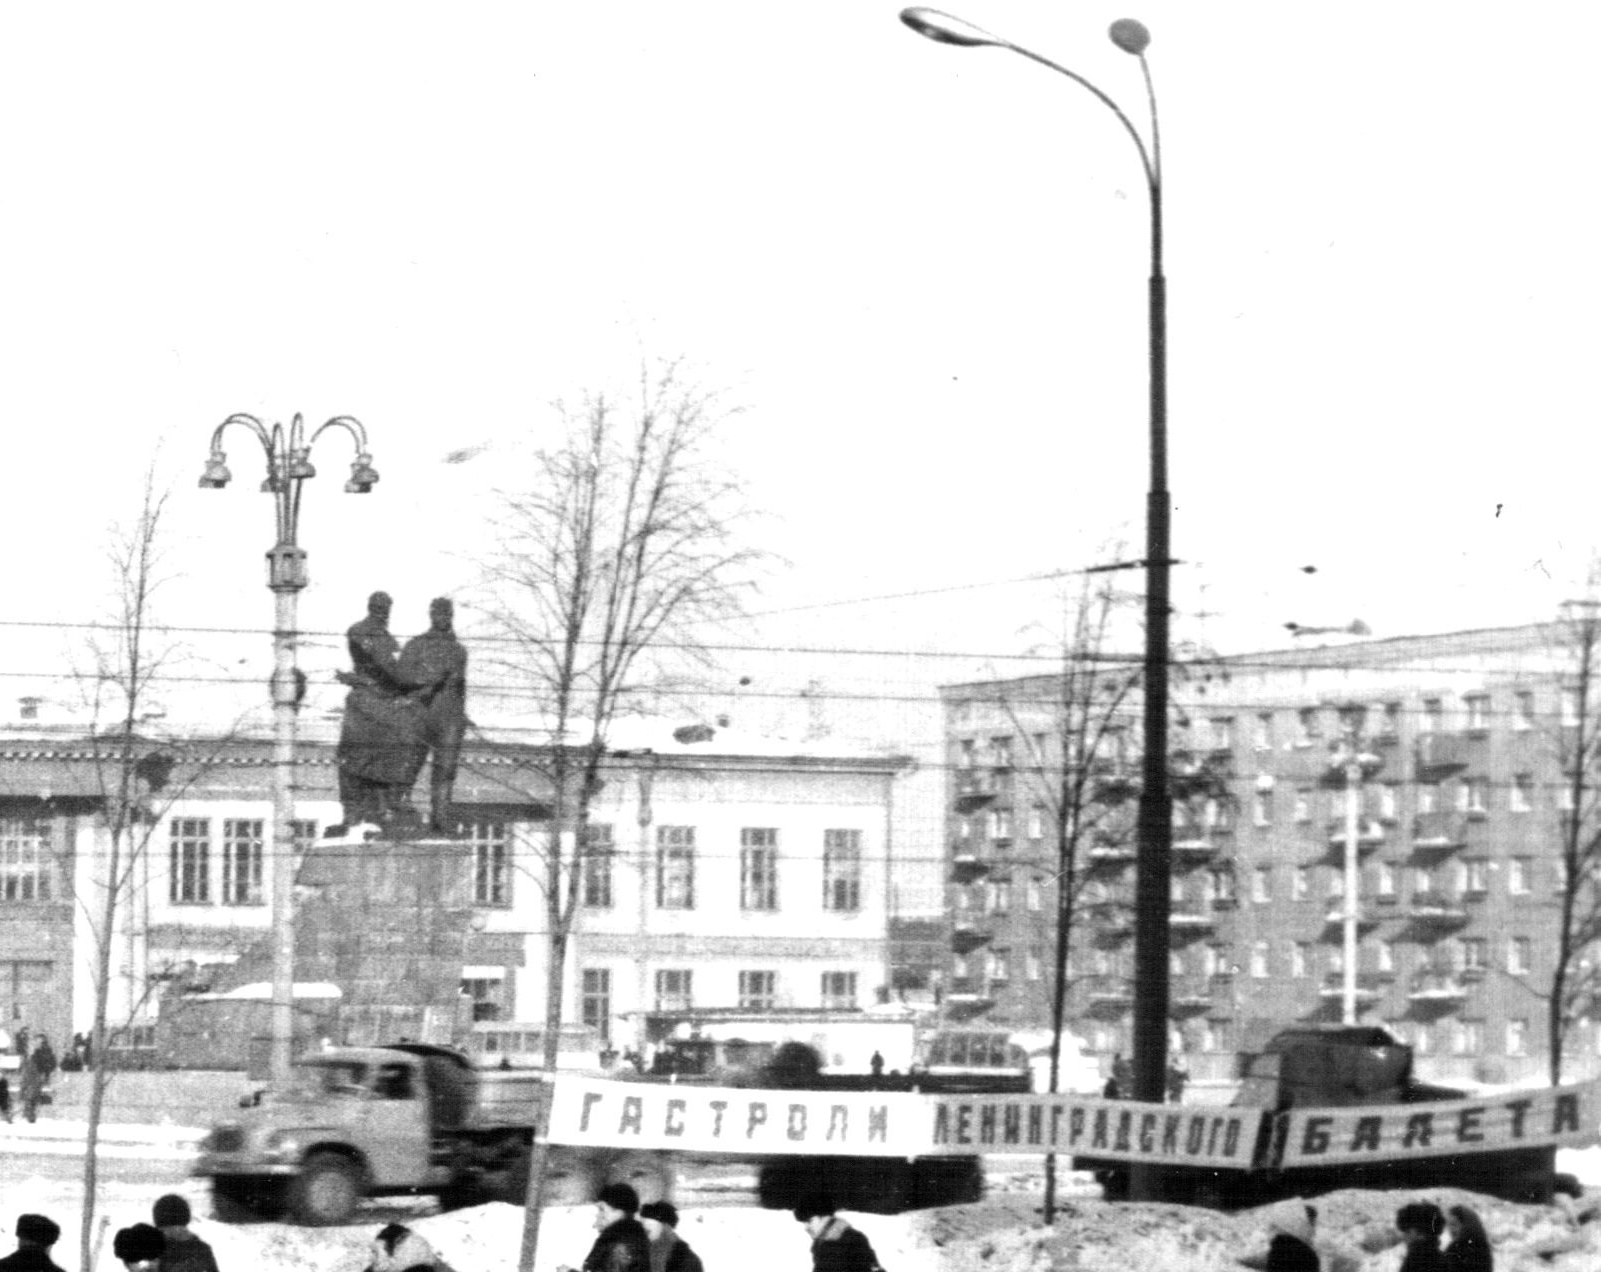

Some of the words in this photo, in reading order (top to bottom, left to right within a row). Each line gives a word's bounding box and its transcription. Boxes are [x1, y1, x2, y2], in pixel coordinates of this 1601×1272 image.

[579, 1091, 889, 1143] ГАСТРОЛИ
[933, 1102, 1242, 1158] ЛЕНИНГРАДСКОГО
[1301, 1092, 1580, 1155] БАЛЕТА
